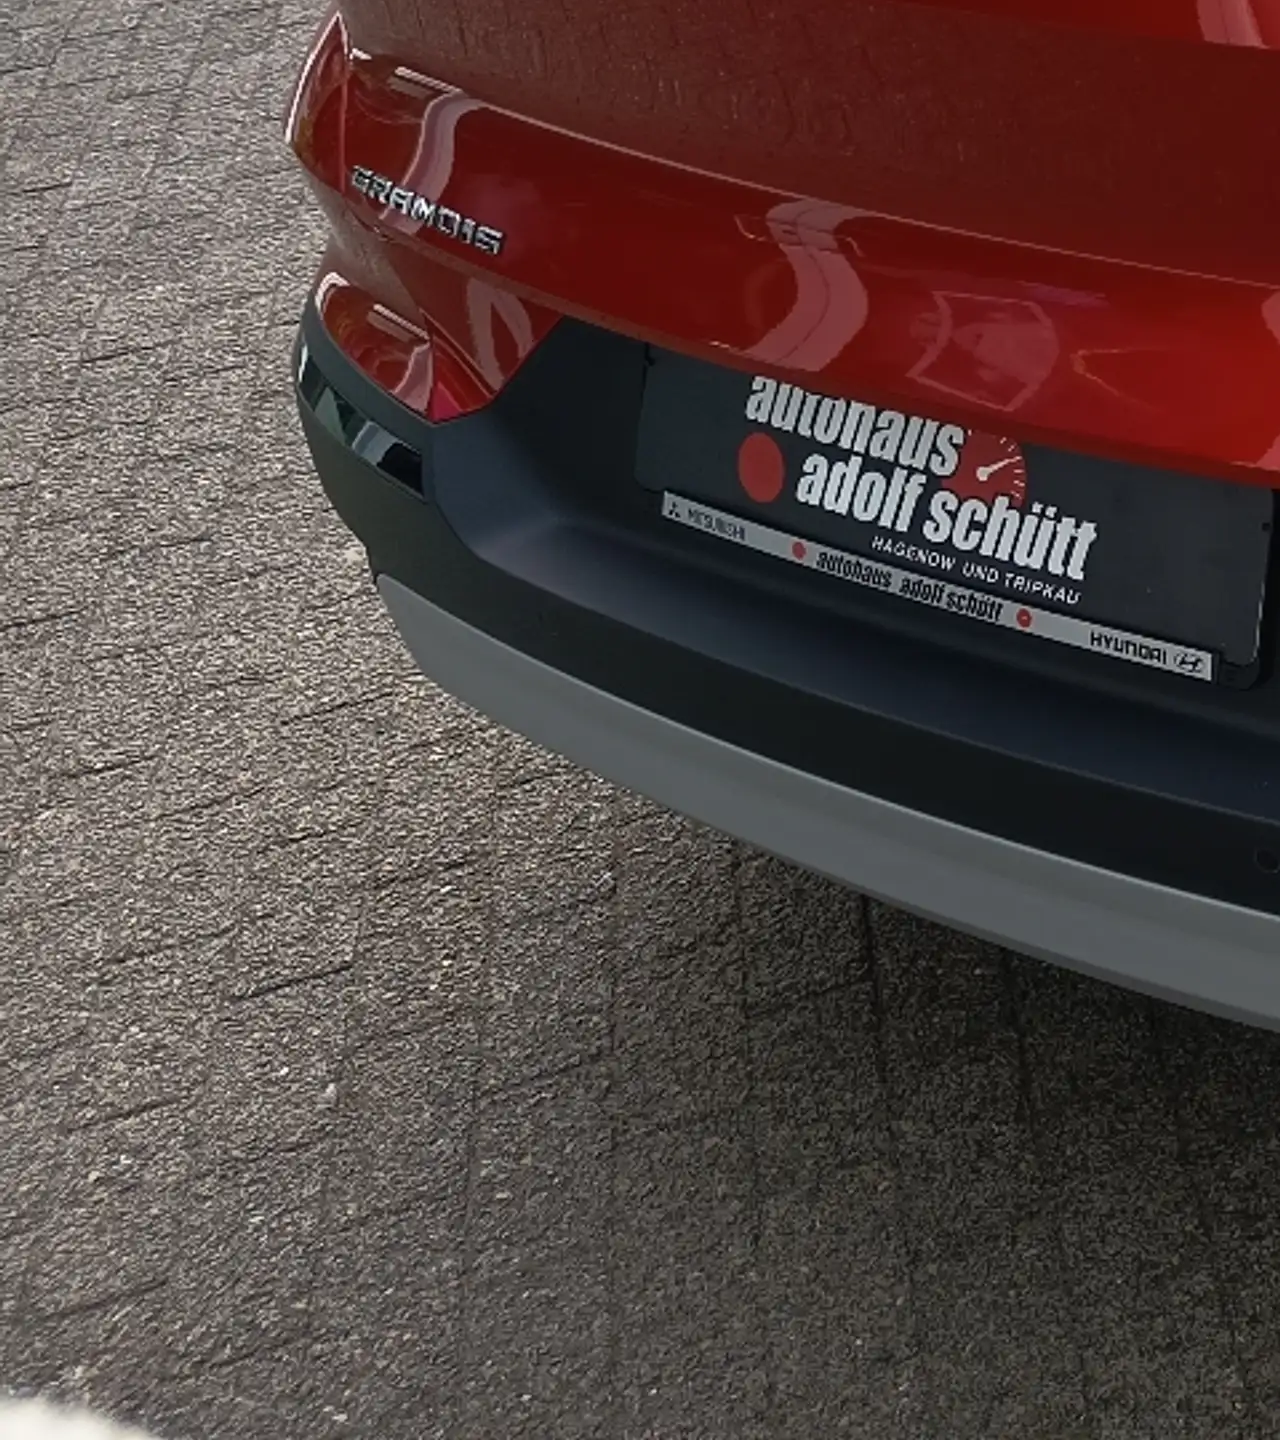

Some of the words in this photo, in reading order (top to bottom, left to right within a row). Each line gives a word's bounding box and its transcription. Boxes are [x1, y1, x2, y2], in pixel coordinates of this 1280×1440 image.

[352, 165, 503, 255] GRANDIS
[745, 375, 966, 477] autohaus
[795, 453, 927, 534] adolf
[922, 490, 1099, 581] schütt
[816, 551, 892, 588] autohaus
[899, 574, 945, 610] adolf
[1090, 630, 1167, 666] HYUNDAI
[871, 535, 957, 572] HAGENOW
[962, 561, 999, 585] UND
[1003, 570, 1082, 606] TRIPKAU
